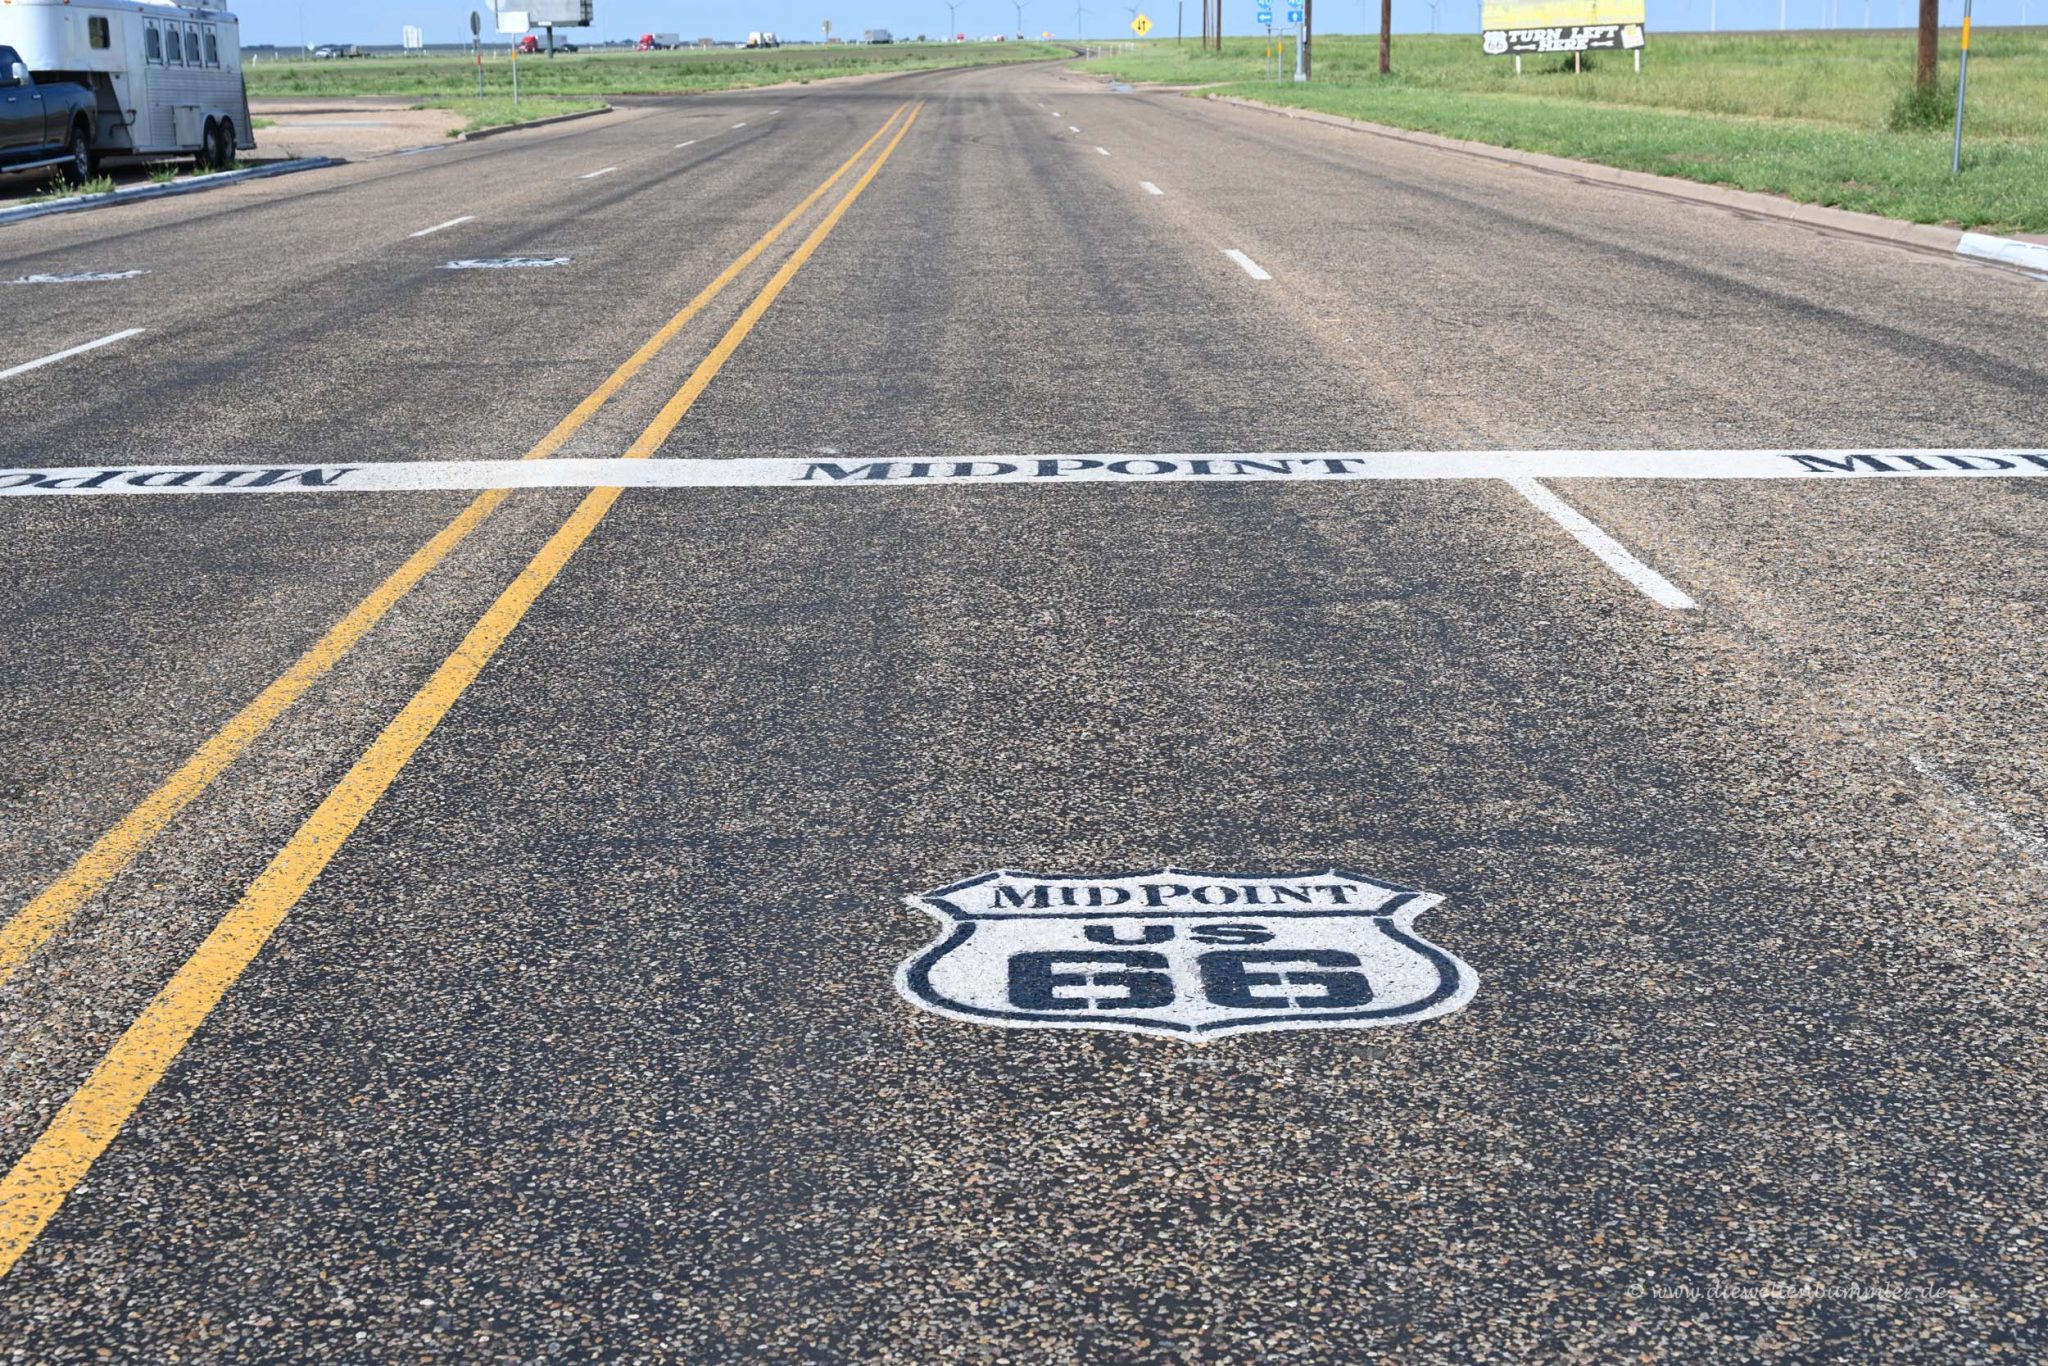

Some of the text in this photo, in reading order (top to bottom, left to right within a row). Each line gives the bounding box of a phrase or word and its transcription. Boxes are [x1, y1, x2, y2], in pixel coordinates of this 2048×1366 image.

[1508, 25, 1619, 43] TURN LEFT
[1537, 38, 1590, 52] HERE
[791, 457, 1365, 482] MIDPOINT
[989, 883, 1359, 910] MIDPOINT
[1083, 923, 1277, 945] US
[1006, 949, 1375, 1011] 66
